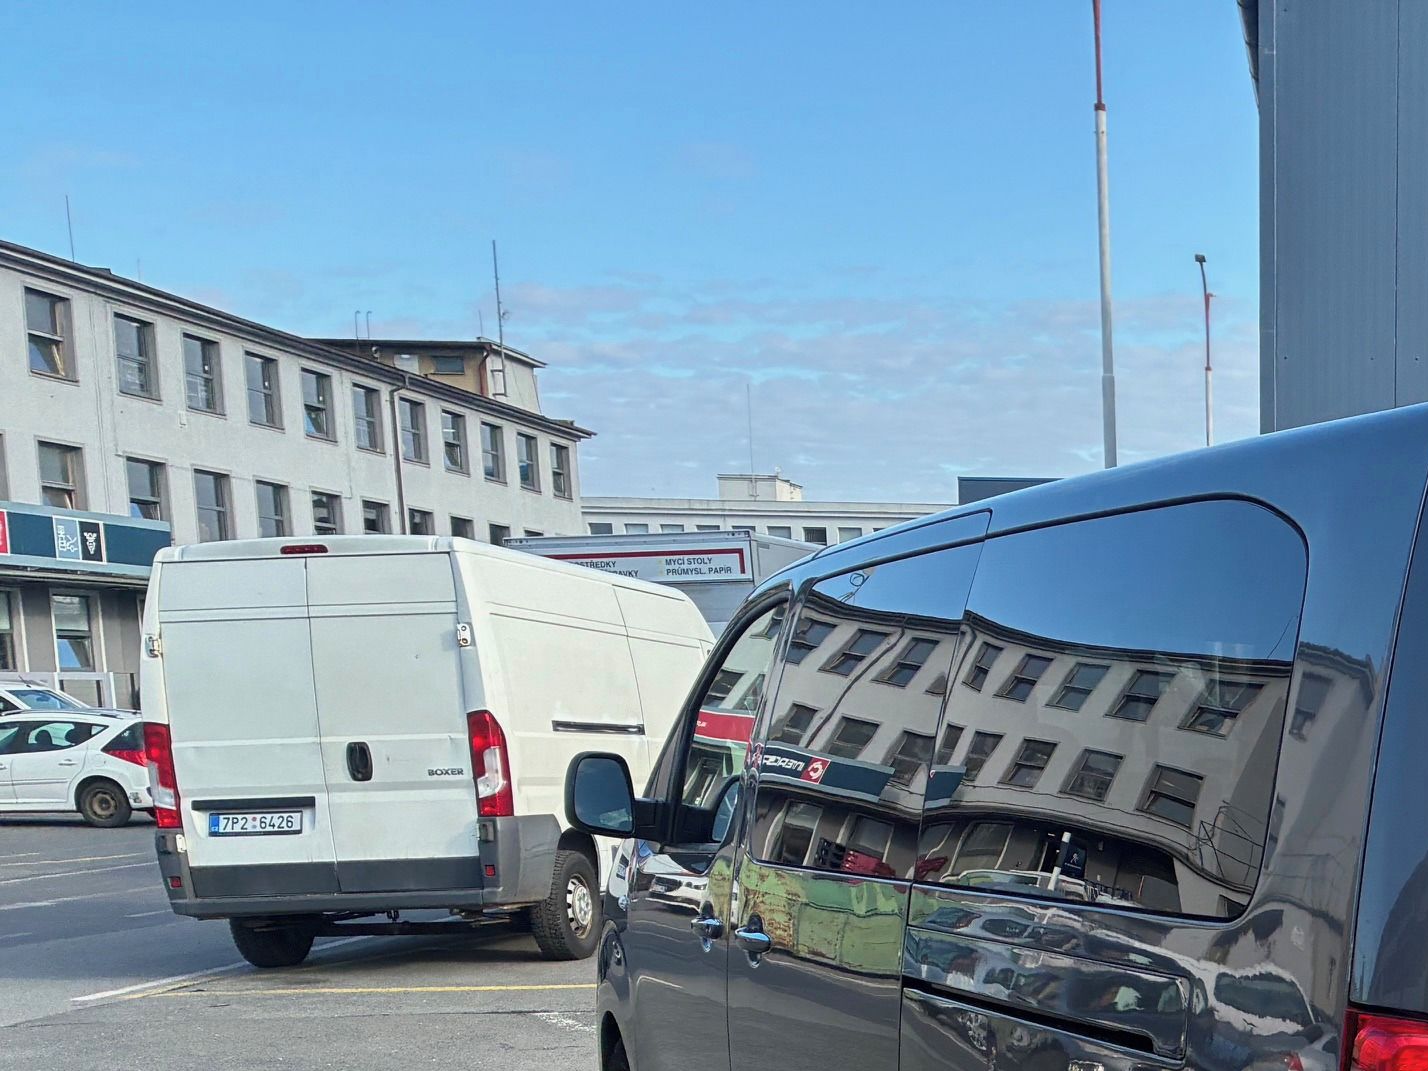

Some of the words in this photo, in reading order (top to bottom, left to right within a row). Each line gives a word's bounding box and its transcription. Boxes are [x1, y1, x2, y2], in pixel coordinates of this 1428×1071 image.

[665, 557, 685, 566] MYCÍ
[687, 557, 712, 566] STOLY
[708, 565, 732, 575] PAPÍR
[427, 768, 464, 776] BOXER
[222, 816, 248, 831] 7P2
[259, 815, 294, 830] 6426
